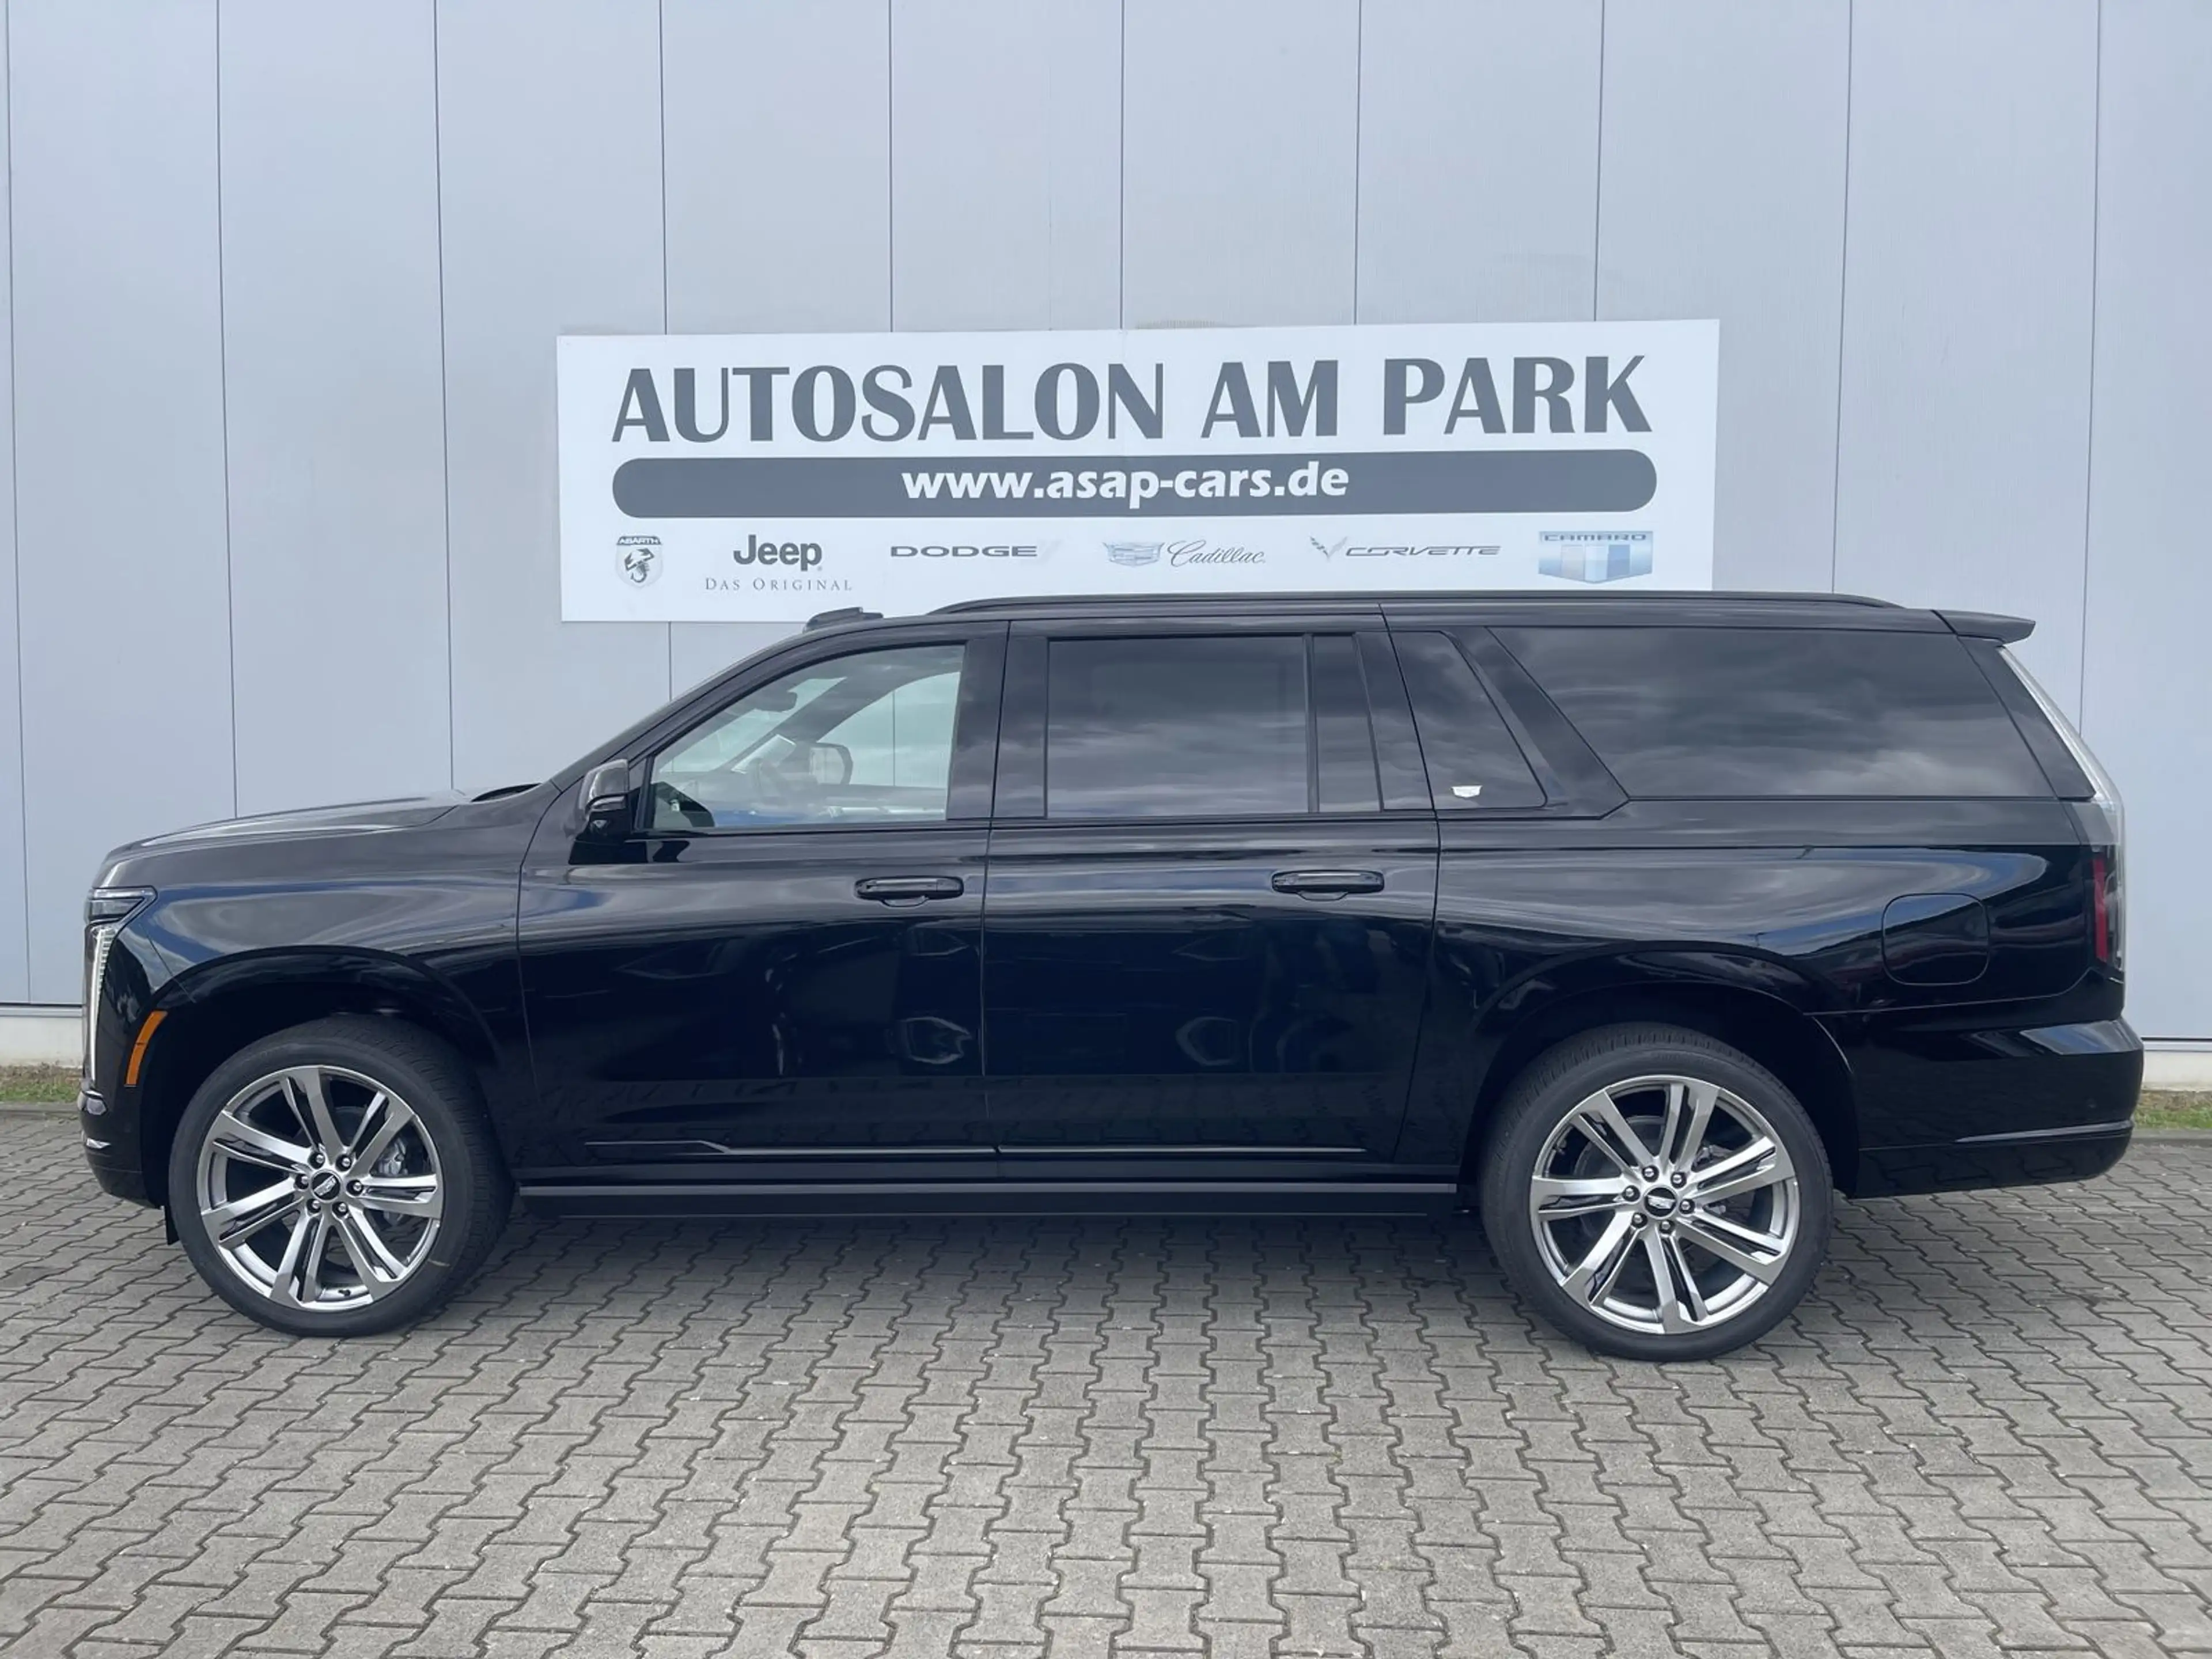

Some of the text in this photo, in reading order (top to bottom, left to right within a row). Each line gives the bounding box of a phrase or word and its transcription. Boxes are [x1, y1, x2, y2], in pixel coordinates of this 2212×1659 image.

[611, 355, 1653, 442] AUTOSALON AM PARK
[902, 461, 1349, 509] www.asap-cars.de
[1544, 533, 1647, 541] CAMARO
[733, 533, 823, 571] Jeep
[891, 546, 1037, 557] DODGE
[1167, 539, 1264, 566] Cadillac
[1346, 546, 1501, 556] CORVETTE
